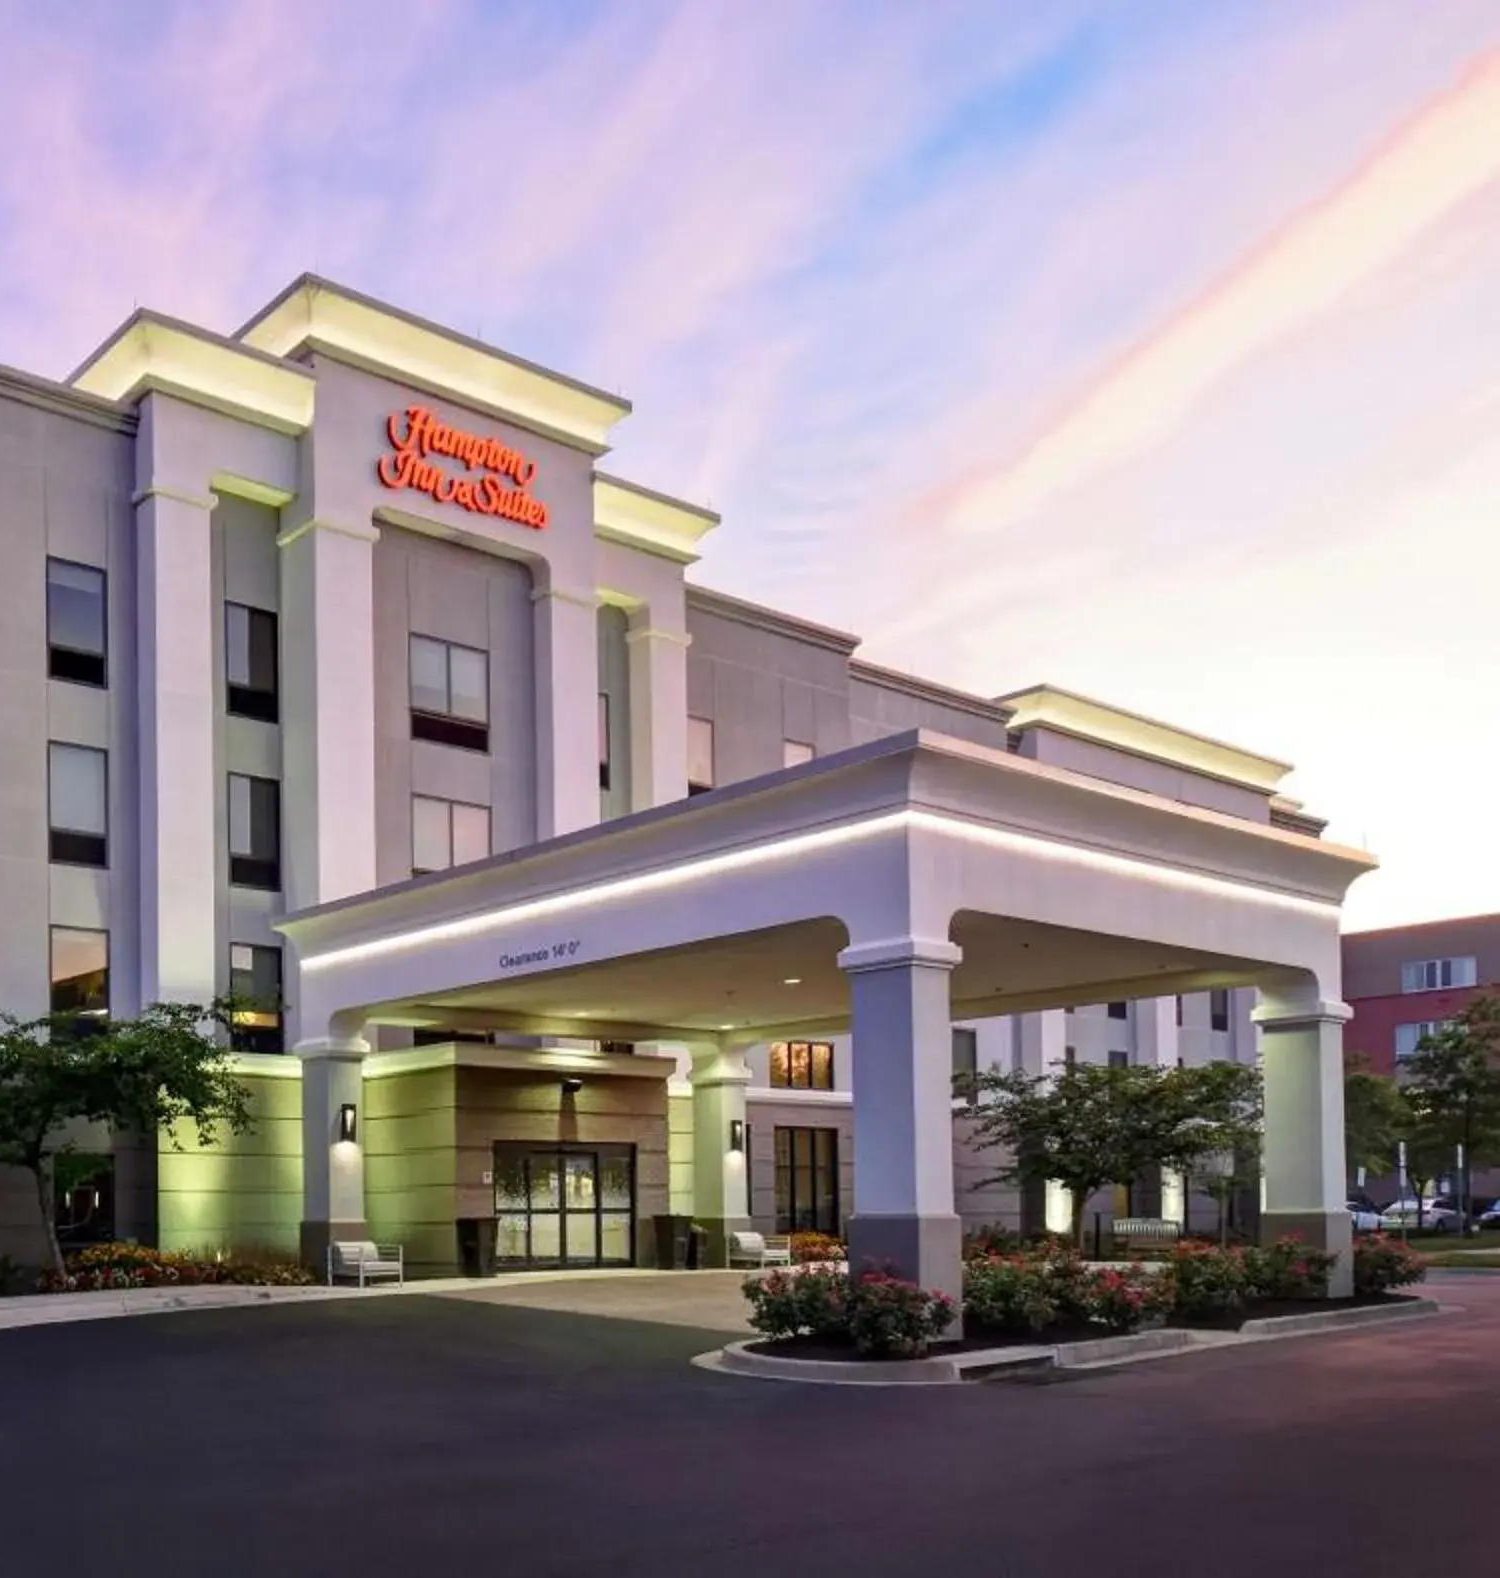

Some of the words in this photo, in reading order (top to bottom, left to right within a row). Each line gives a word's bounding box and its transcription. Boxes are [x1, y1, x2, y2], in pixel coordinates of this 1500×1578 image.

[387, 405, 537, 488] Hampton
[378, 450, 457, 502] Inn
[474, 474, 548, 529] Suites
[500, 949, 549, 968] Clearance
